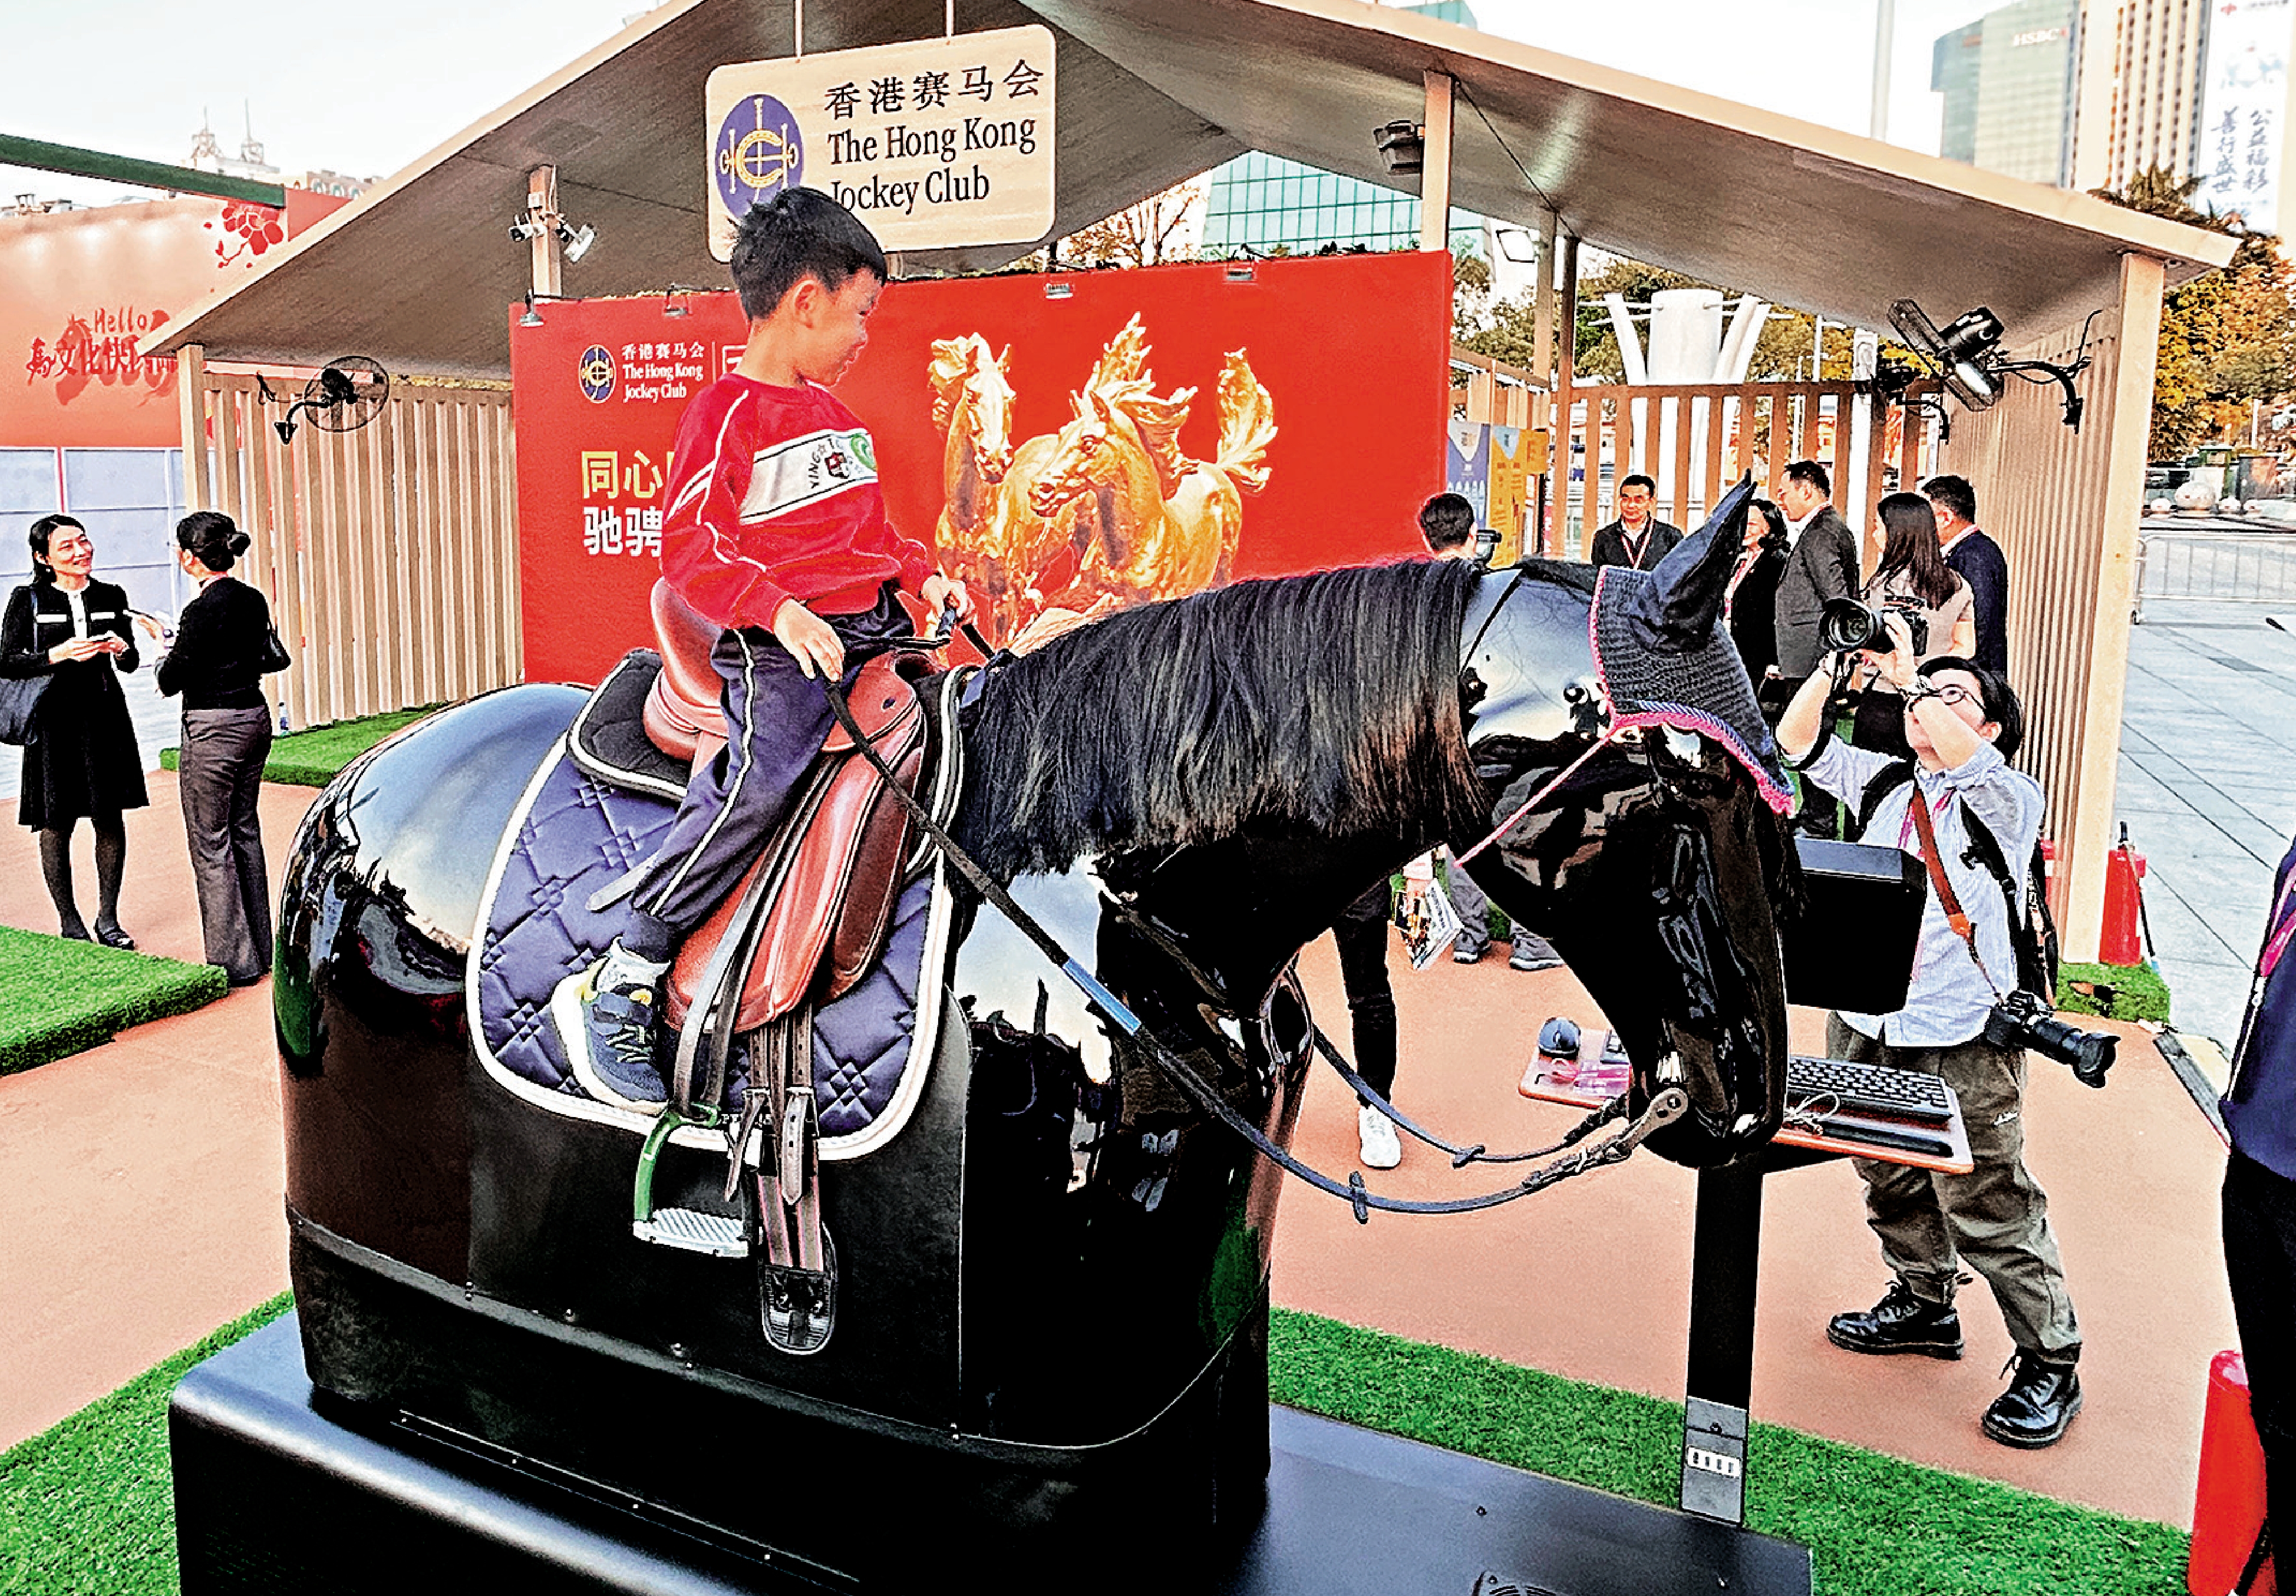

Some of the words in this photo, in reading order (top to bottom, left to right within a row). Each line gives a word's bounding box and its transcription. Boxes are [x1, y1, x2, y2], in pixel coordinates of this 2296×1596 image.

[824, 59, 1044, 120] 香港赛马会
[827, 128, 877, 165] The
[885, 124, 956, 162] Hong
[964, 117, 1036, 154] Kong
[831, 175, 919, 216] Jockey
[925, 164, 989, 204] Club
[95, 305, 147, 334] Hello
[622, 341, 705, 361] 香港赛马会
[622, 362, 644, 379] The
[645, 363, 674, 381] Hong
[675, 362, 704, 381] Kong
[623, 382, 658, 404] Jockey
[661, 381, 687, 398] Club
[582, 450, 675, 499] 同心
